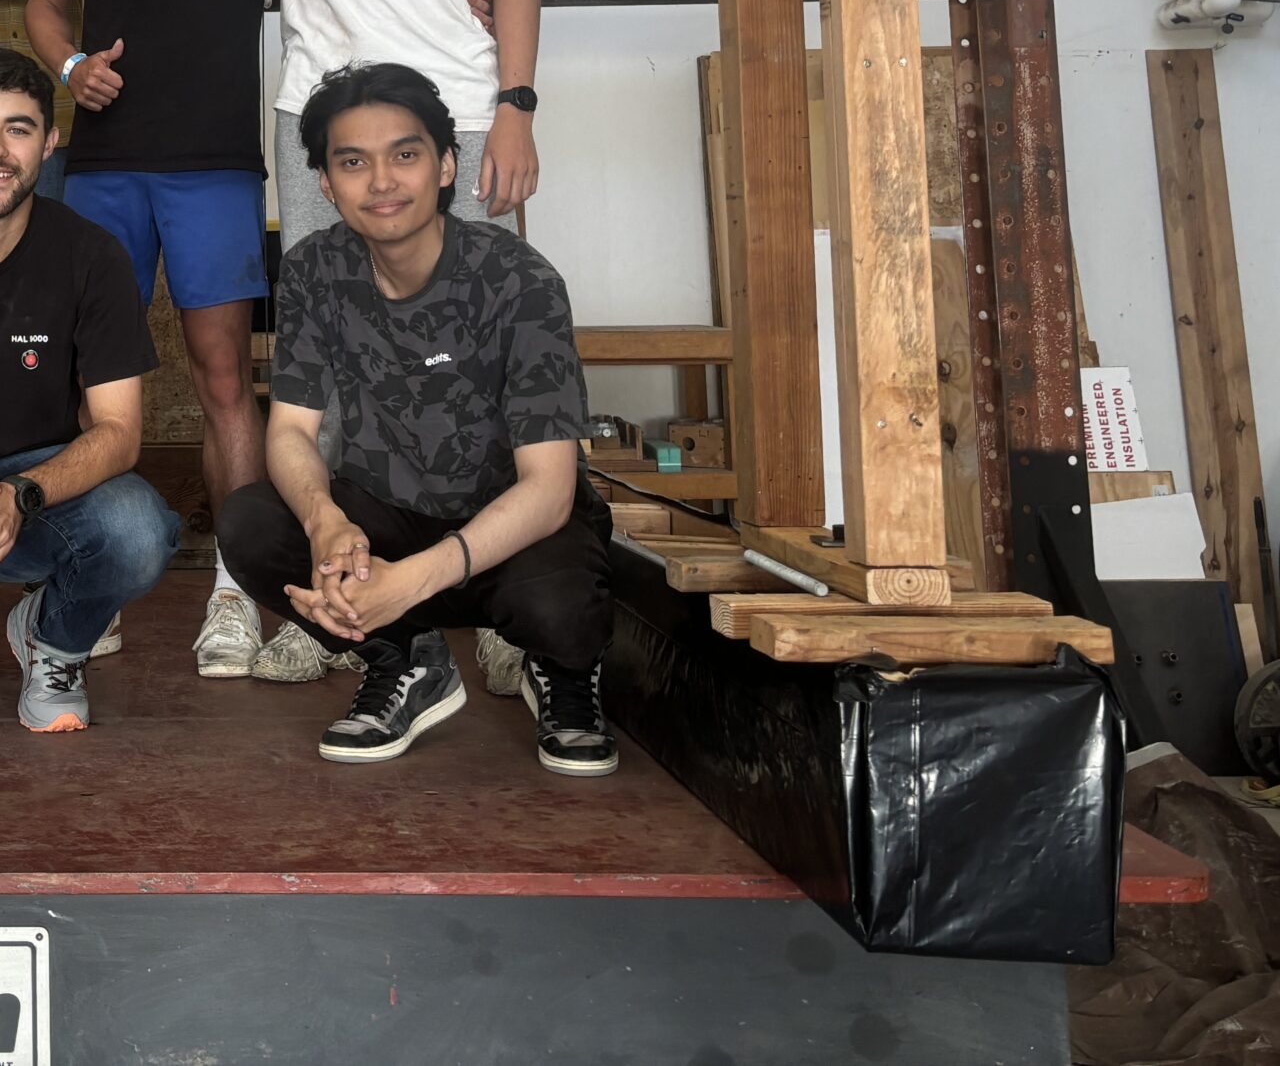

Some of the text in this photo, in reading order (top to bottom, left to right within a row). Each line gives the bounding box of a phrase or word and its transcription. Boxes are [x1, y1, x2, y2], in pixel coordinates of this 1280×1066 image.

[11, 335, 28, 343] HAL
[1093, 382, 1117, 469] ENGINEERED
[1112, 388, 1136, 468] INSULATION
